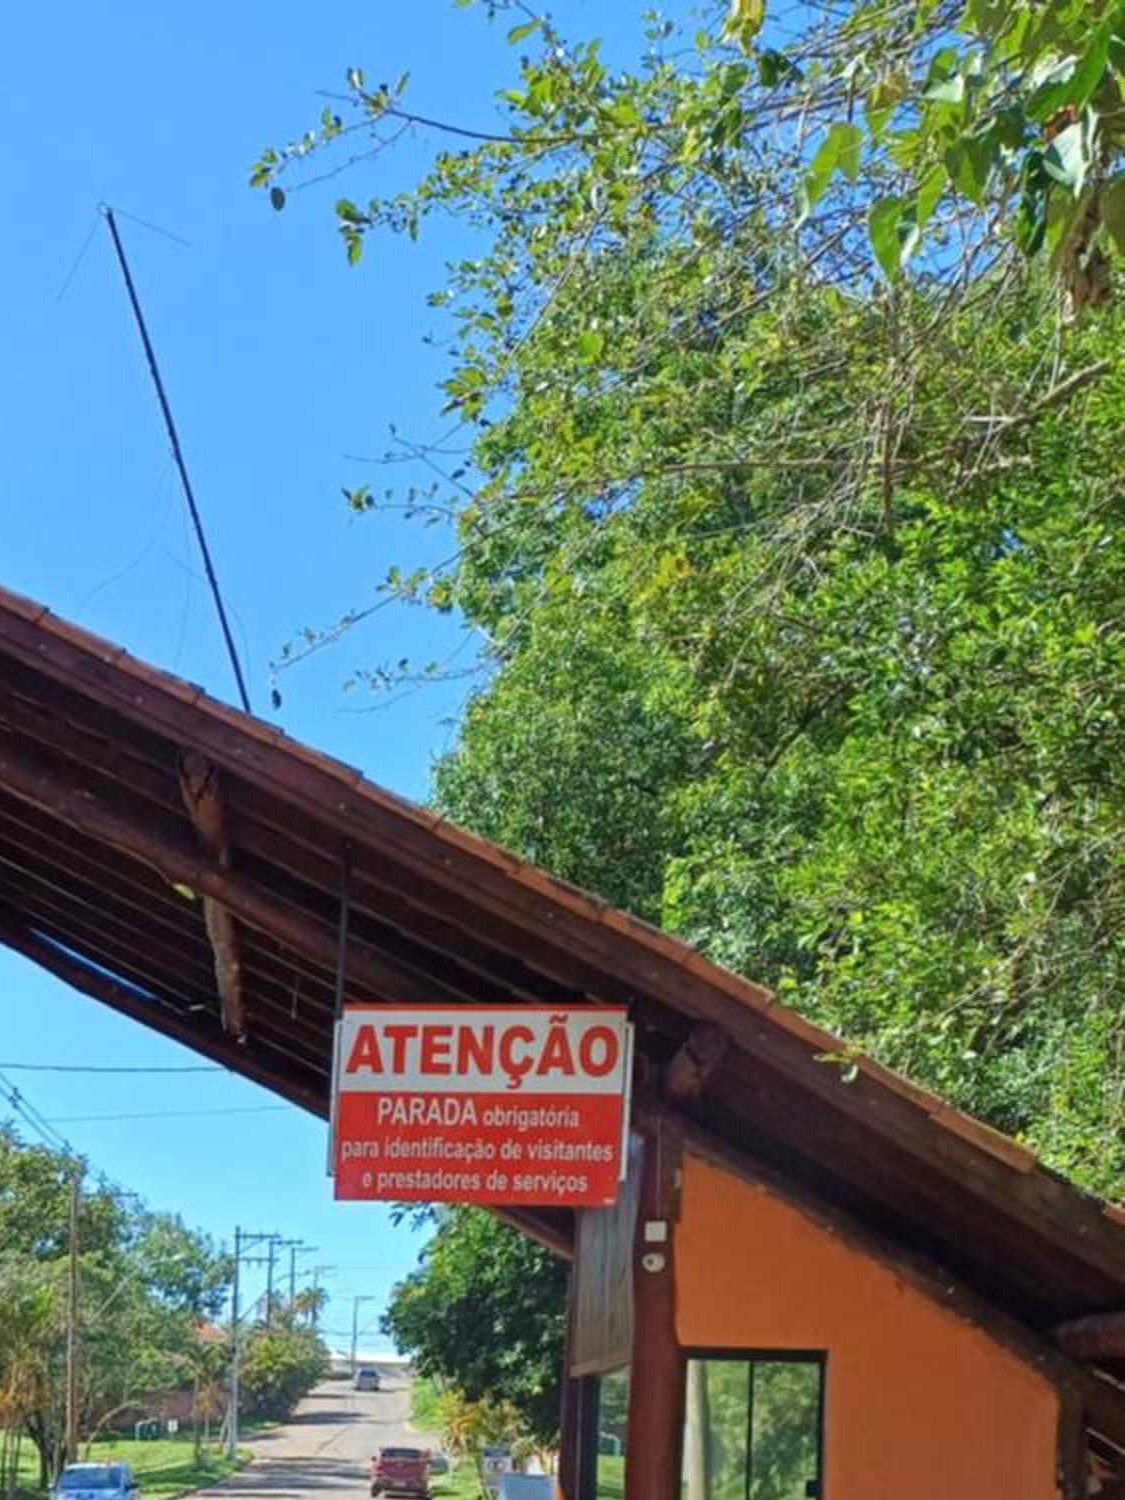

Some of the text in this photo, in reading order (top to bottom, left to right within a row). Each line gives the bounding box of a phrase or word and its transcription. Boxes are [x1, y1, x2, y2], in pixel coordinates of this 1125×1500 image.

[345, 1014, 620, 1089] ATENÇÃO
[377, 1097, 580, 1131] PARADA obrigatória
[341, 1137, 614, 1163] para identificação de visitantes
[362, 1170, 589, 1196] e prestadores de serviços
